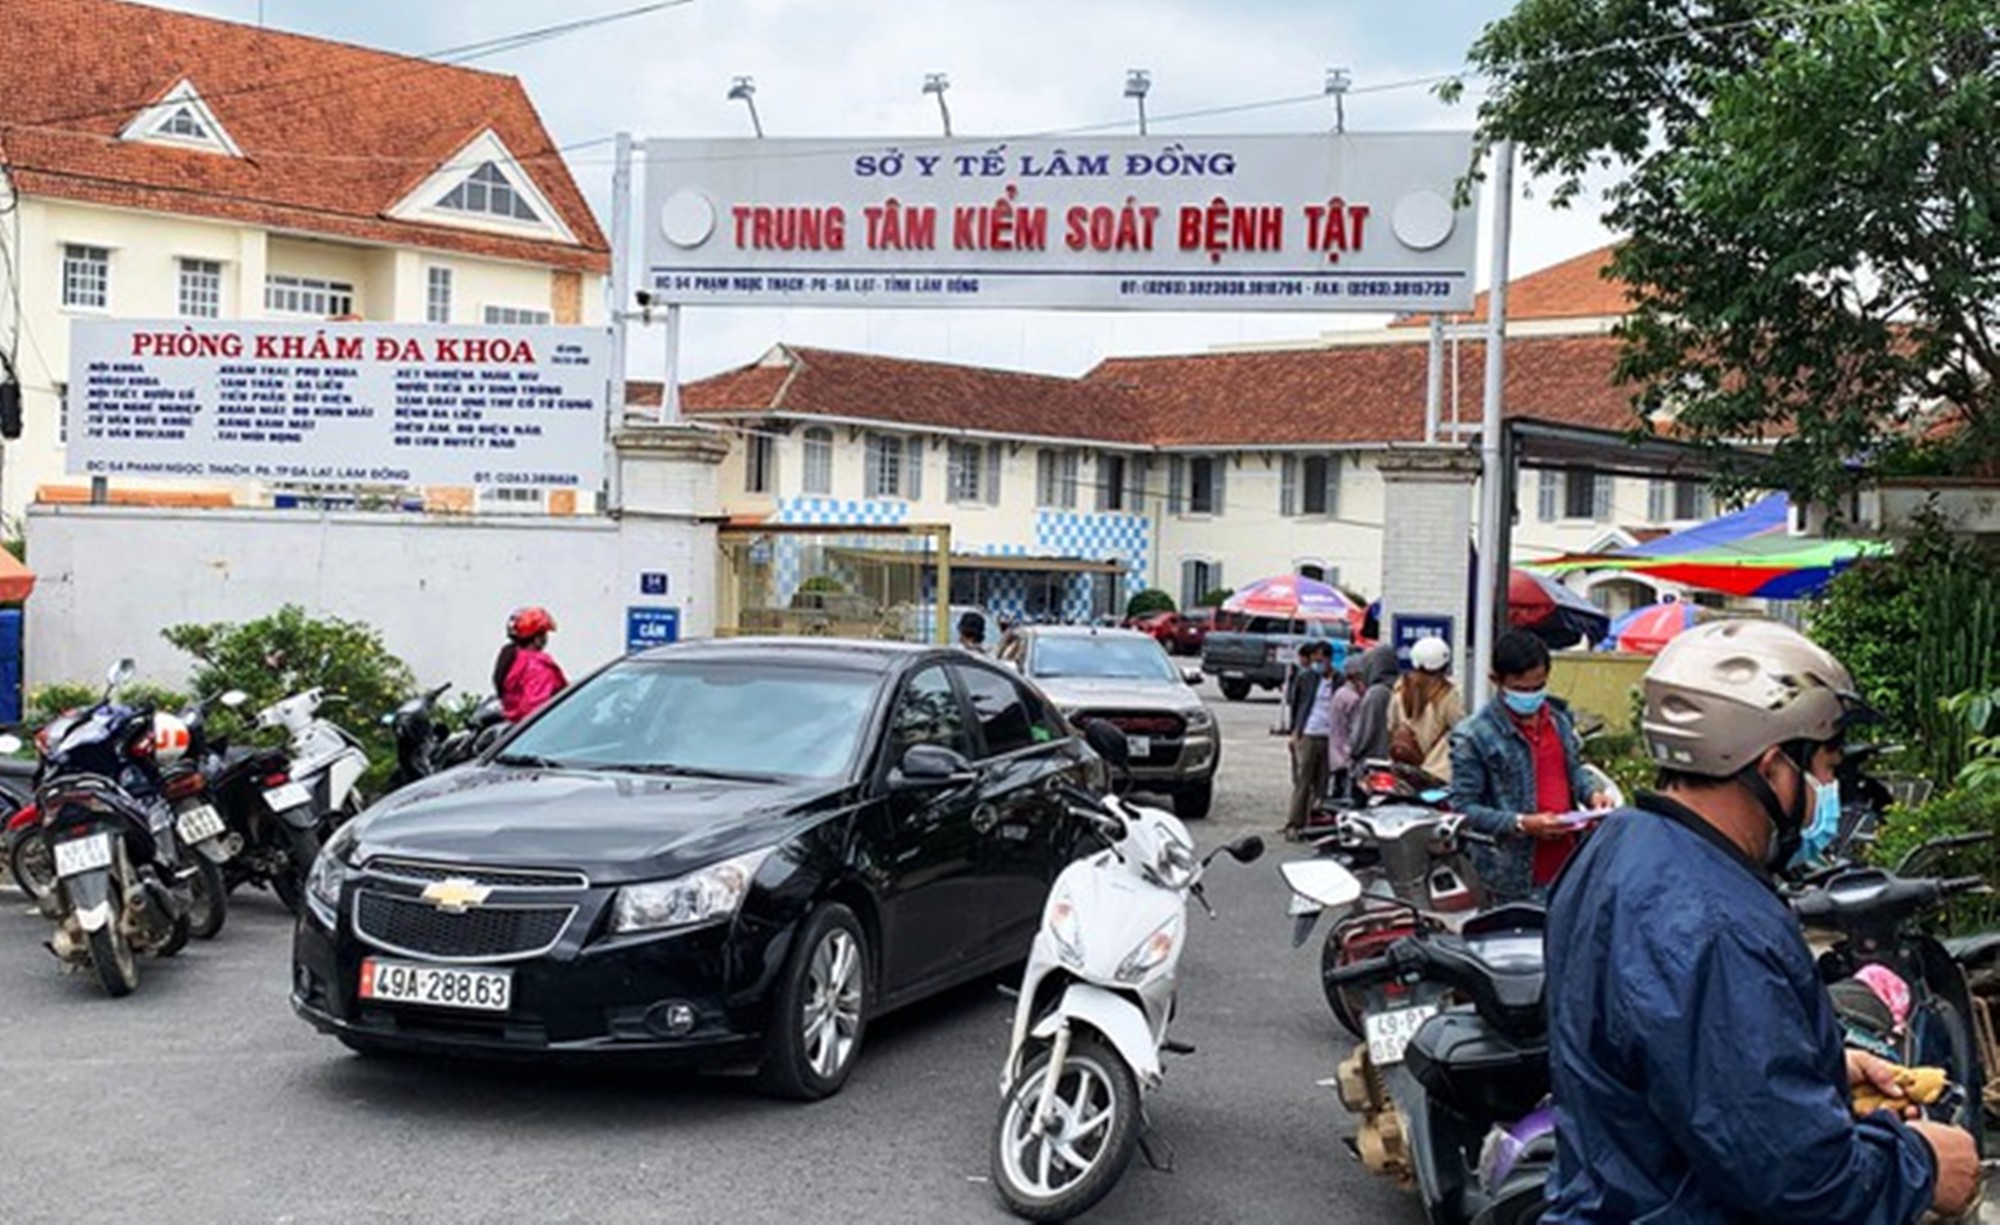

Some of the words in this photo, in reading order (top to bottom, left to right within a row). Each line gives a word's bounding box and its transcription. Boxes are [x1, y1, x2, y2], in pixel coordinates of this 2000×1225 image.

[855, 147, 904, 177] SỞ
[915, 157, 941, 176] Y
[953, 145, 1007, 177] TẾ
[1019, 150, 1110, 177] LÂM
[1125, 144, 1237, 176] ĐỒNG
[732, 206, 846, 251] TRUNG
[864, 197, 937, 252] TÂM
[952, 184, 1048, 252] KIỂM
[1065, 196, 1161, 252] SOÁT
[1179, 196, 1284, 264] BỆNH
[1304, 196, 1370, 264] TẬT
[675, 276, 690, 290] 54
[131, 326, 243, 358] PHÒNG
[254, 330, 364, 361] KHÁM
[375, 338, 424, 361] ĐA
[435, 338, 536, 364] KHOA
